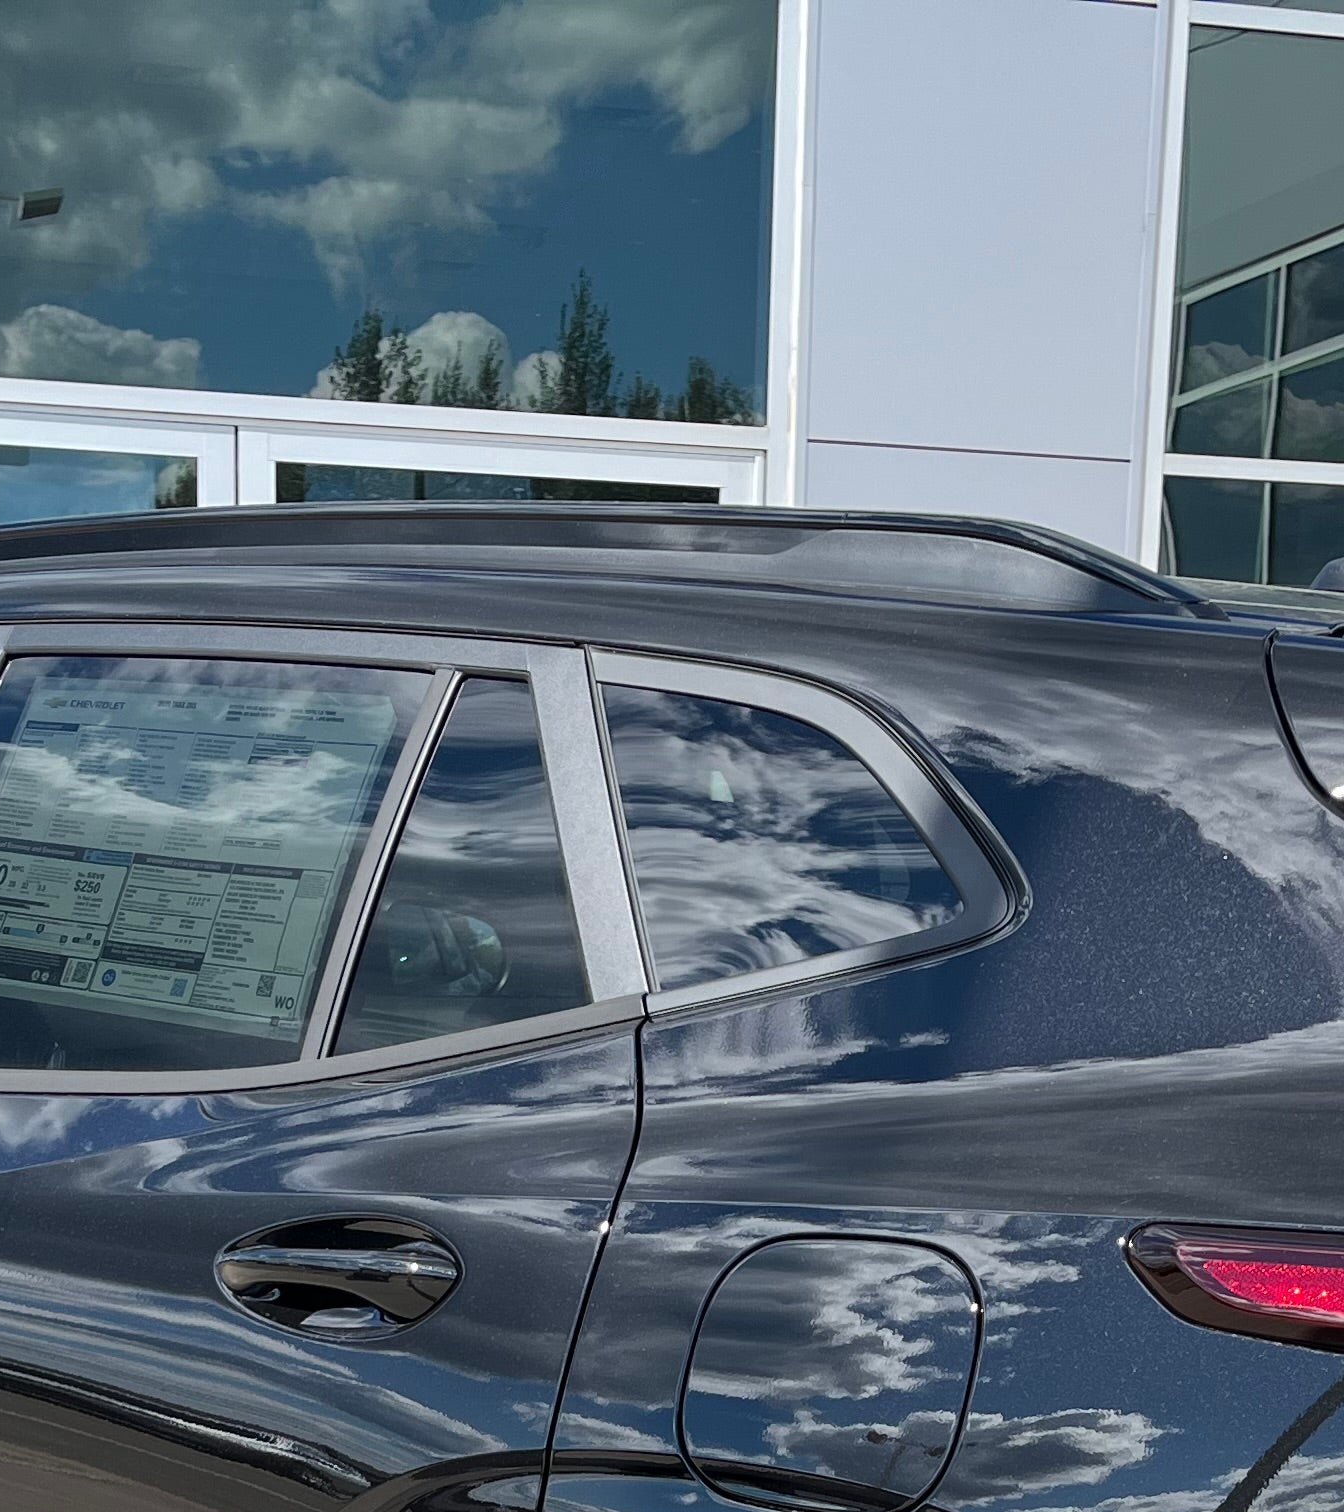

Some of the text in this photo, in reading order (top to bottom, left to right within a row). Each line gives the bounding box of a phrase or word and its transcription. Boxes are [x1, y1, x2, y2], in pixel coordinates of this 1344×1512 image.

[70, 700, 126, 710] CHEVROLET
[73, 879, 102, 894] $250
[274, 995, 295, 1010] WO
